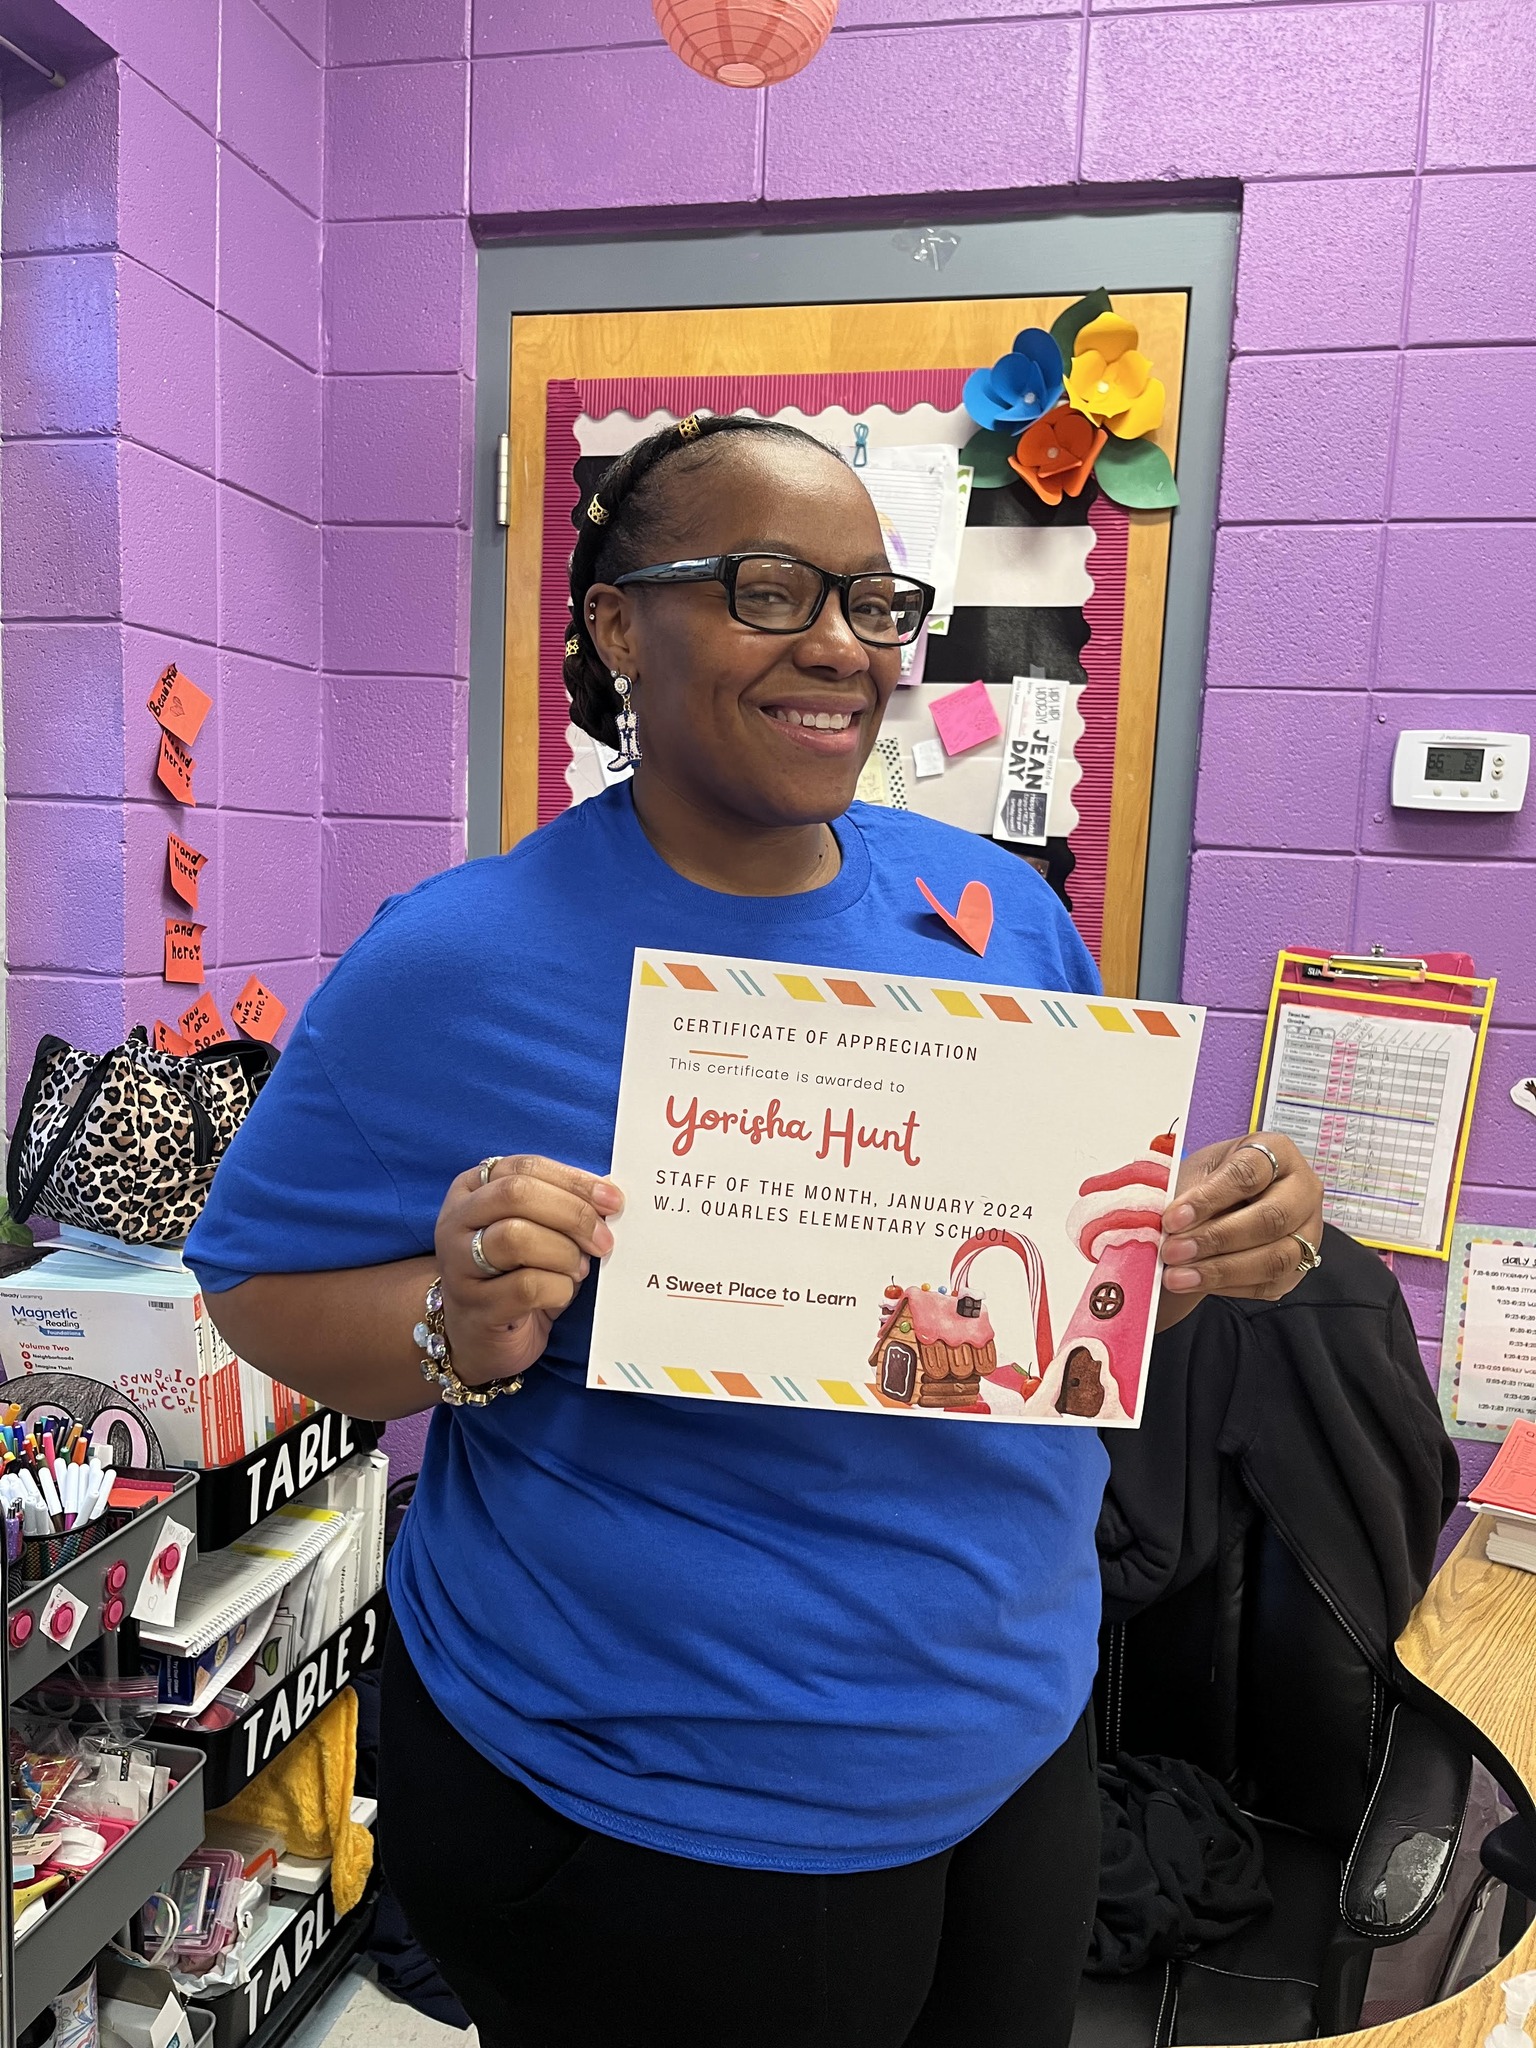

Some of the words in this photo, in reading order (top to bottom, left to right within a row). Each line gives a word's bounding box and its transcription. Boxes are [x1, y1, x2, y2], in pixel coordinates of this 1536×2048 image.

[1008, 740, 1029, 781] DAY
[1025, 729, 1049, 790] JEAN
[194, 1013, 210, 1033] are
[673, 1016, 797, 1042] CERTIFICATE
[806, 1029, 829, 1045] OF
[836, 1033, 977, 1061] APPRECIATION
[669, 1057, 700, 1072] This
[707, 1063, 790, 1081] certificate
[796, 1070, 809, 1083] is
[815, 1074, 883, 1091] awarded
[890, 1081, 905, 1093] to
[665, 1095, 813, 1156] Yorisha
[815, 1107, 921, 1168] Hunt
[656, 1169, 716, 1189] STAFF
[726, 1176, 750, 1193] OF
[759, 1180, 795, 1198] THE
[804, 1184, 877, 1208] MONTH,
[887, 1192, 975, 1215] JANUARY
[983, 1202, 1033, 1220] 2024
[654, 1195, 691, 1213] W.J.
[701, 1200, 789, 1222] QUARLES
[799, 1210, 926, 1235] ELEMENTARY
[934, 1222, 1010, 1243] SCHOOL
[646, 1273, 660, 1289] A
[665, 1275, 723, 1295] Sweet
[728, 1281, 777, 1300] Place
[782, 1287, 800, 1302] to
[806, 1288, 857, 1307] Learn
[11, 1304, 78, 1321] Magnetic
[45, 1319, 80, 1329] Reading
[19, 1342, 50, 1351] Volume
[52, 1344, 70, 1352] Two
[247, 1413, 354, 1525] TABLE
[243, 1626, 352, 1777] TABLE
[361, 1608, 376, 1664] 2
